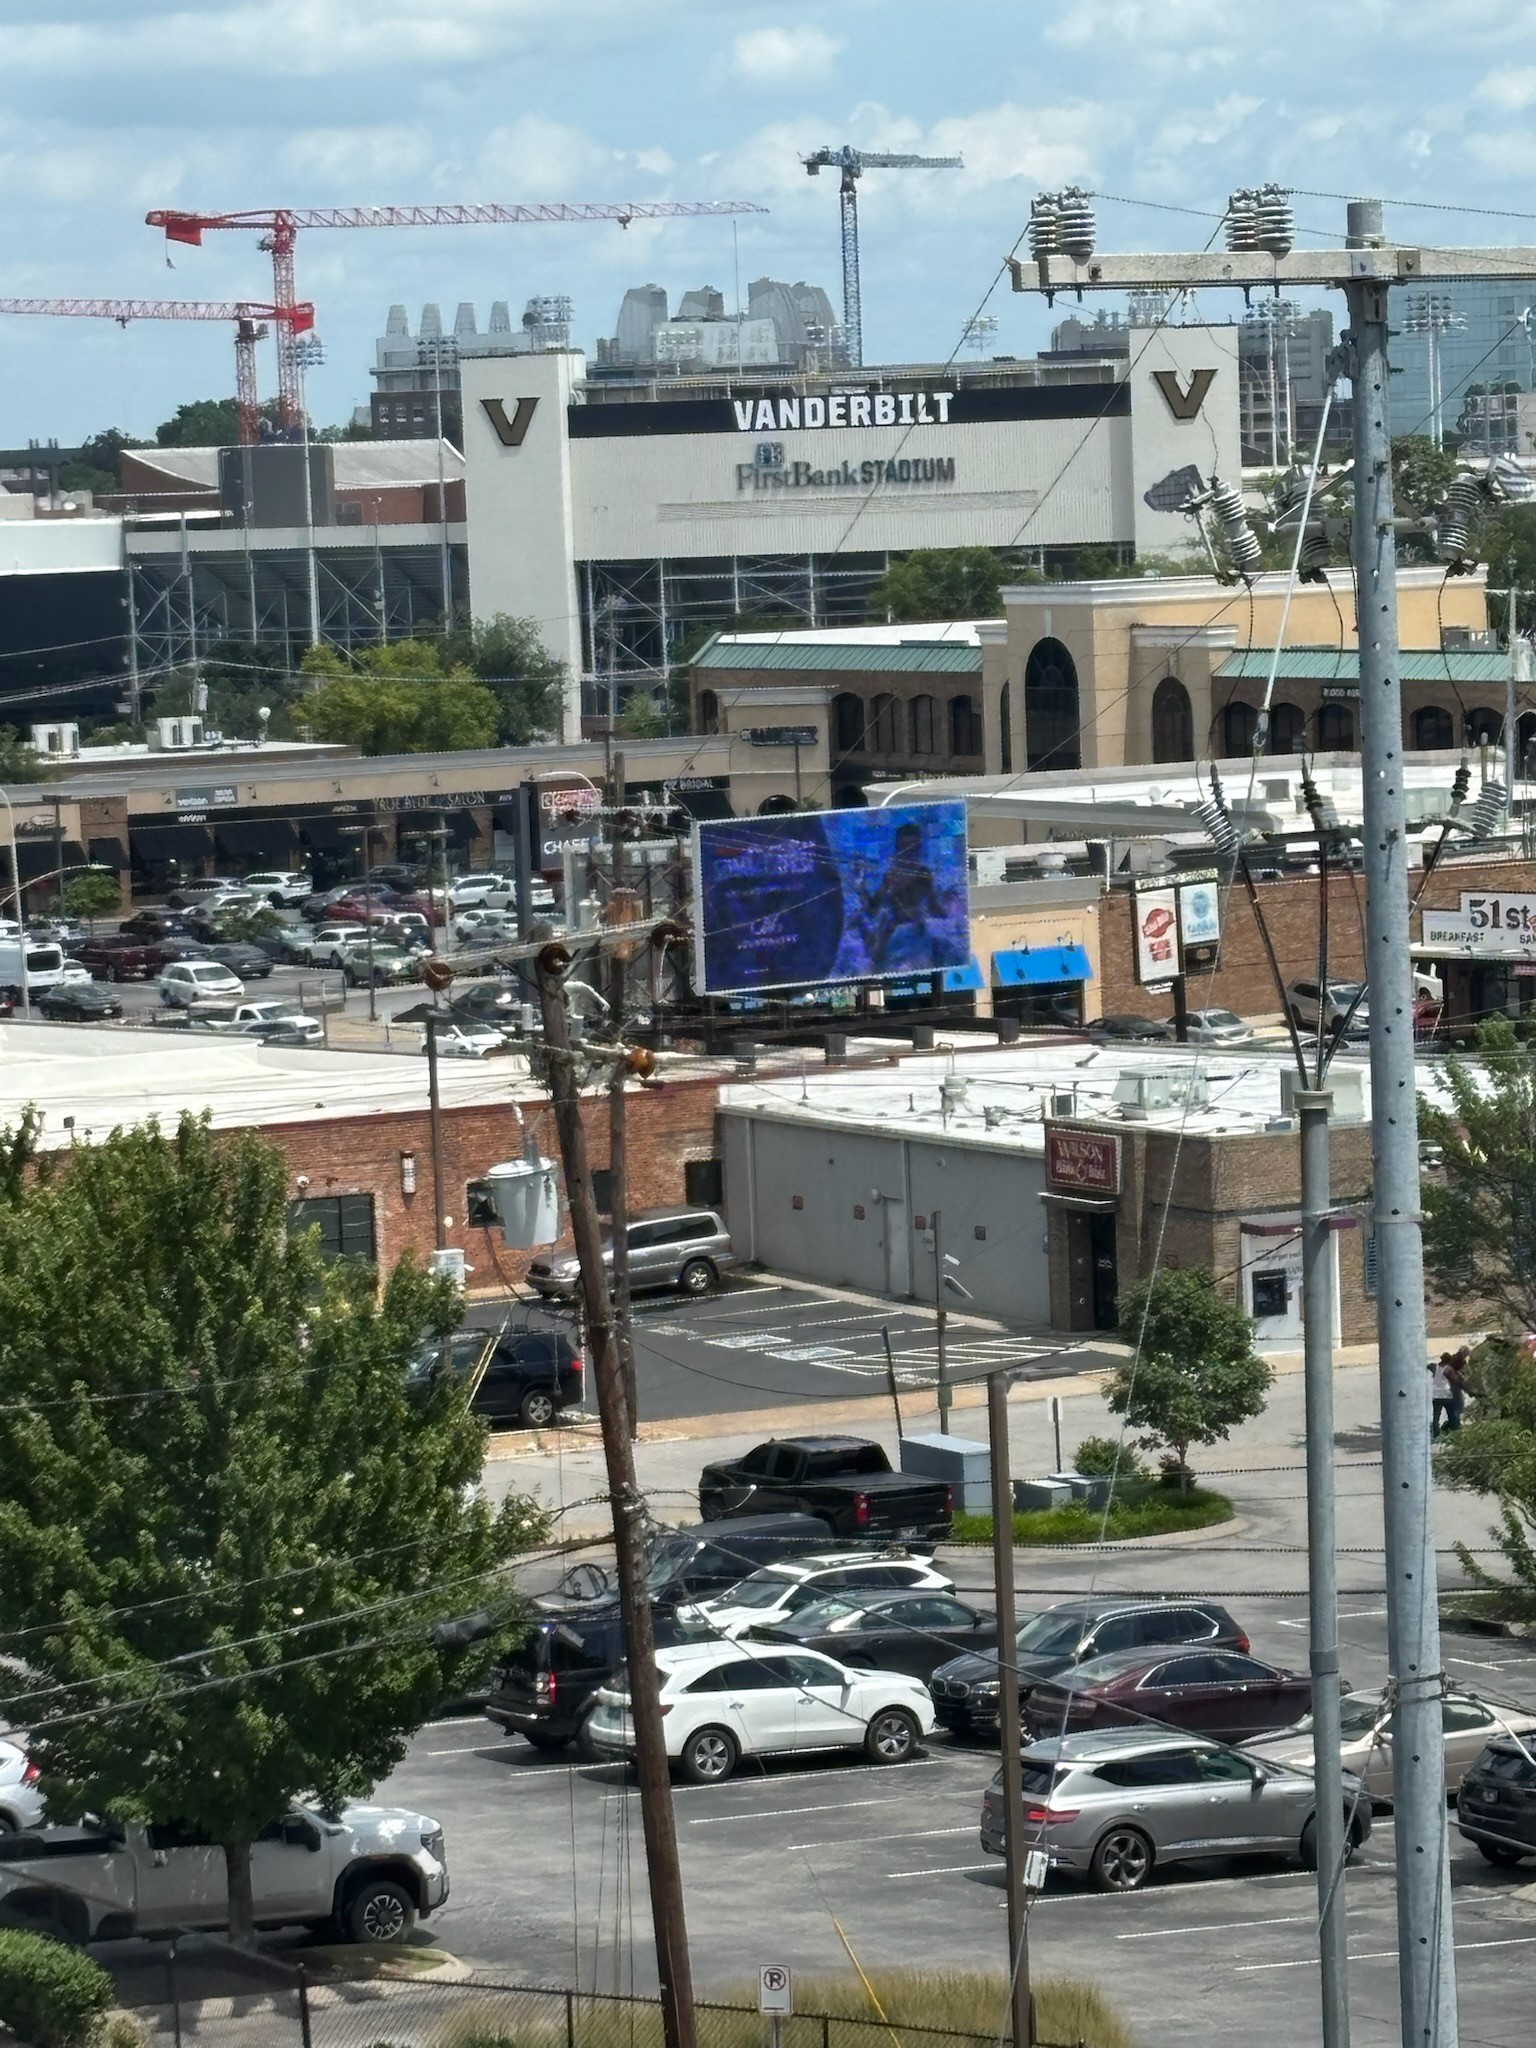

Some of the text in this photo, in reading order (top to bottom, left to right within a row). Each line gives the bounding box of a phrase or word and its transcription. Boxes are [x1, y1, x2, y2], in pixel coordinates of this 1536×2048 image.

[733, 392, 954, 431] VANDERBILT
[1150, 368, 1218, 419] V
[479, 397, 541, 446] V
[736, 457, 956, 490] FirstBank STADIUM
[1469, 899, 1531, 931] 51st
[1430, 931, 1485, 943] BREAKFAST
